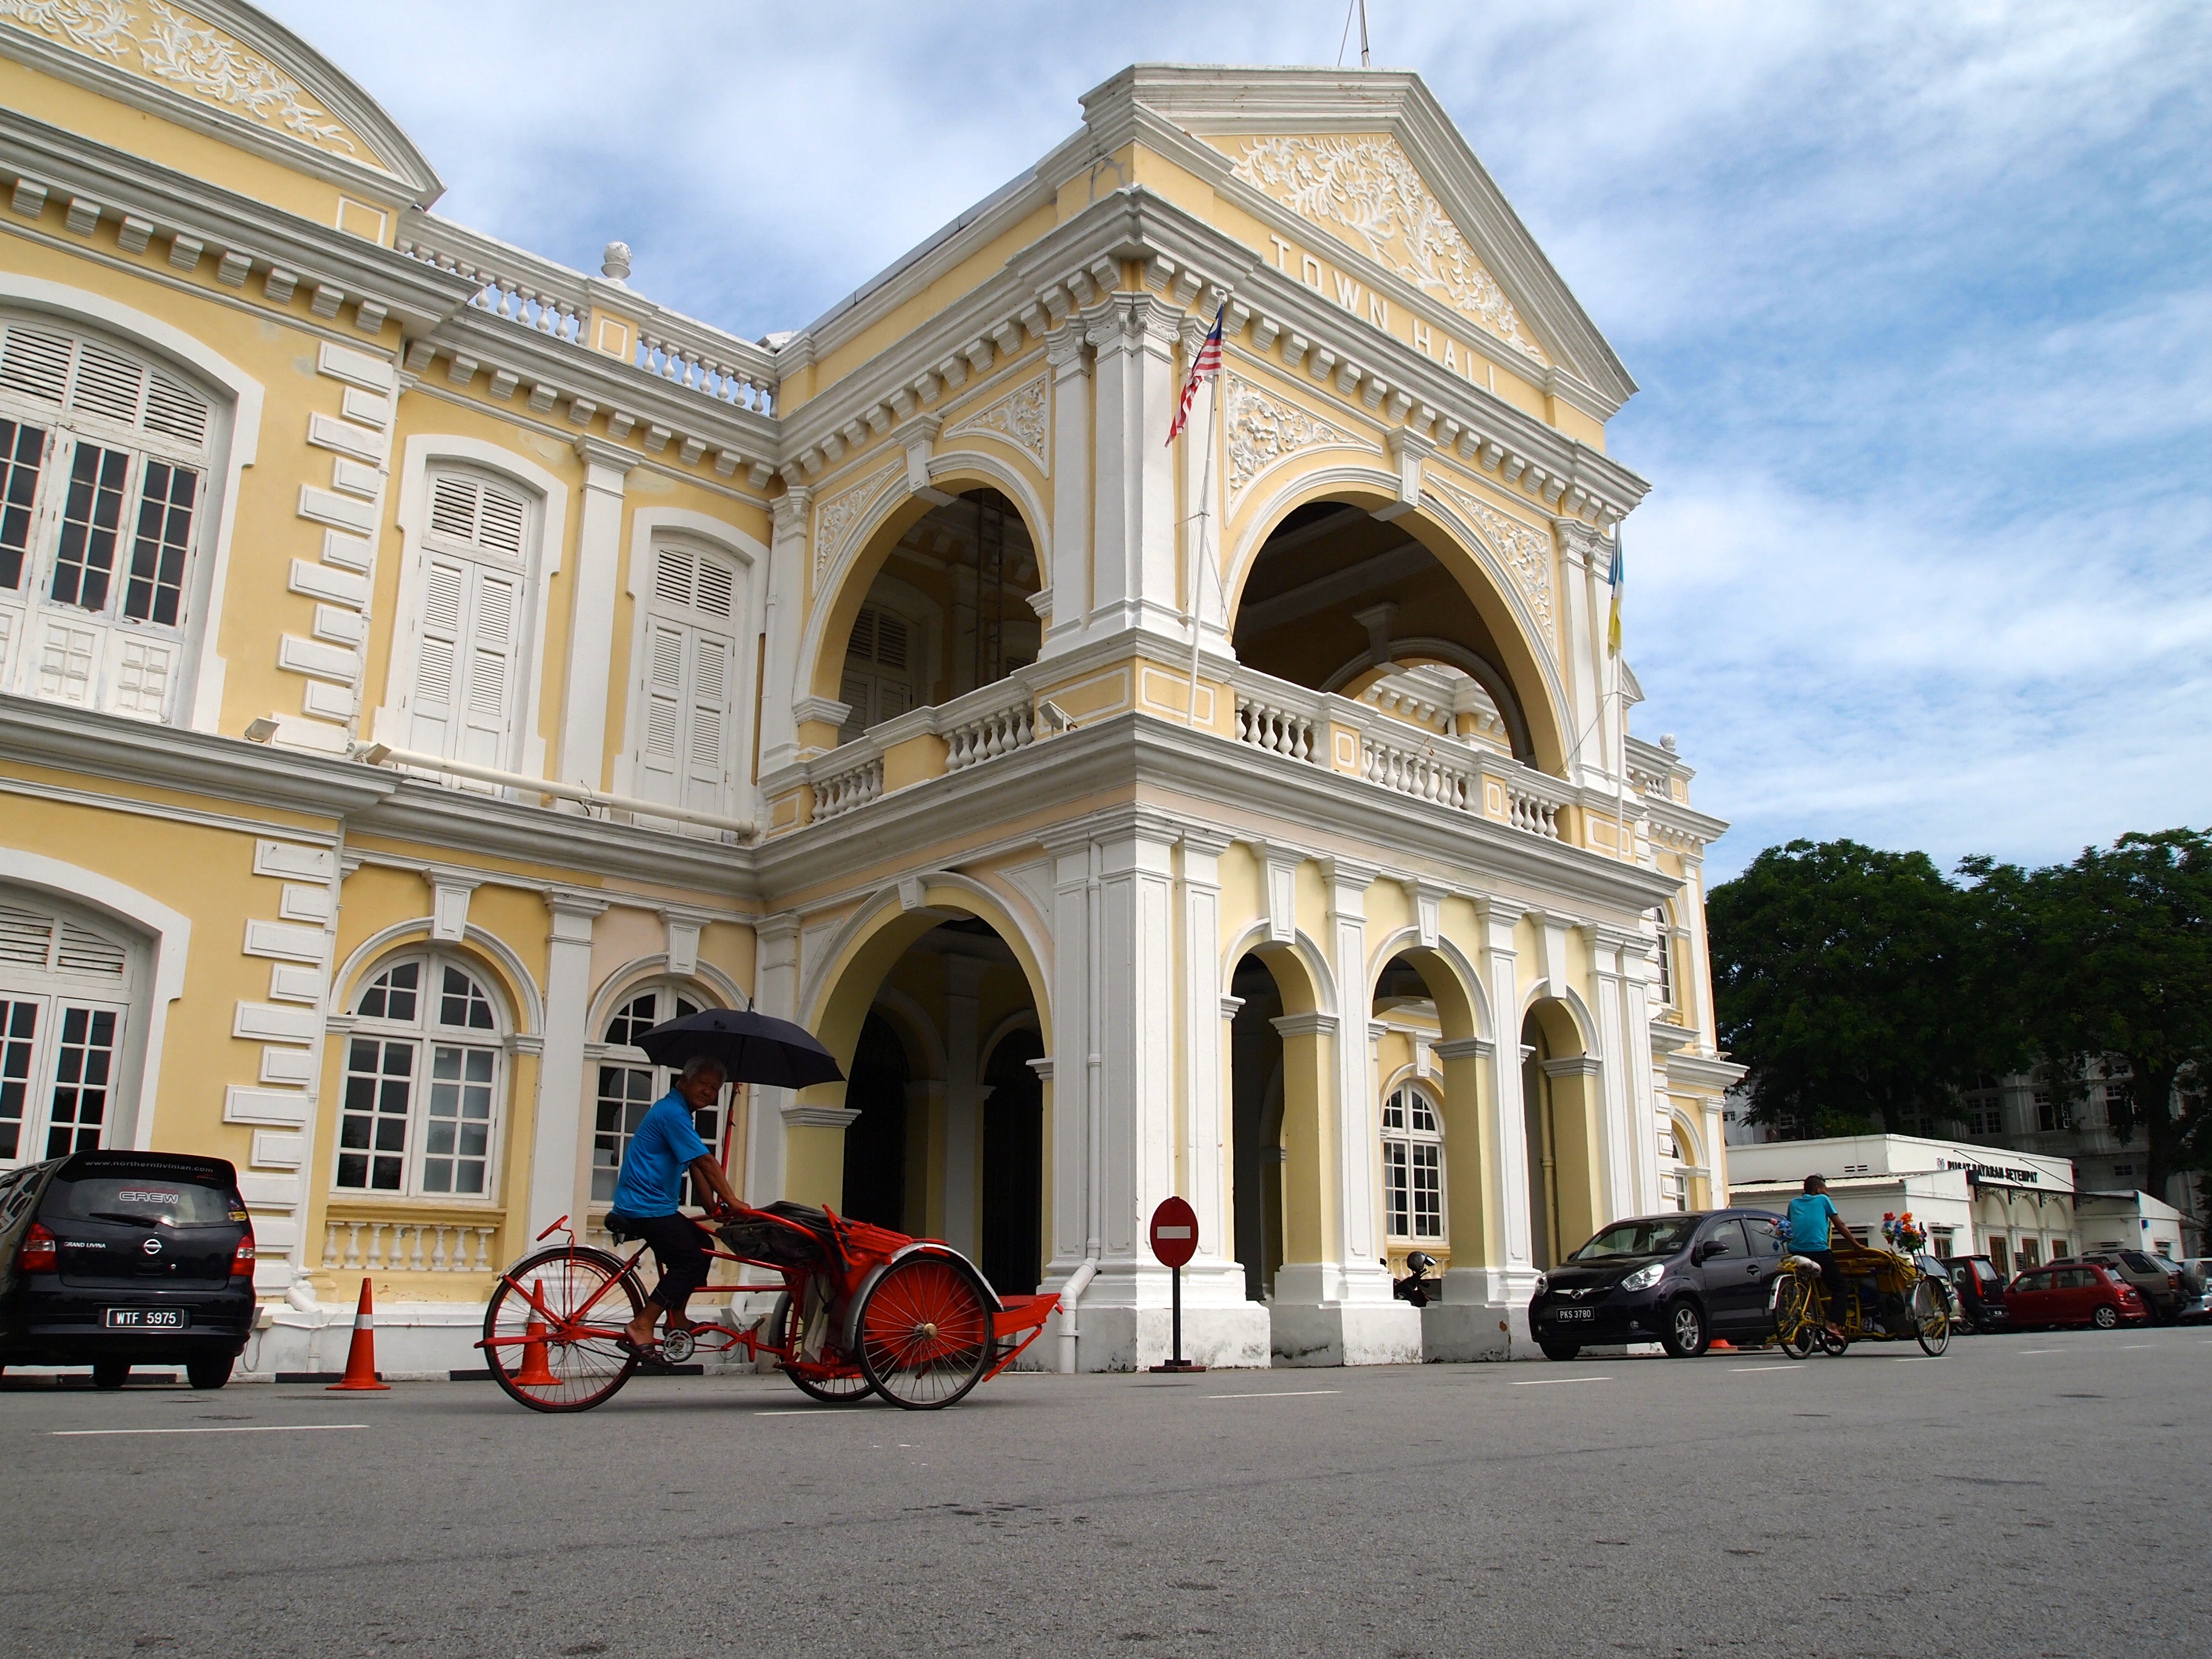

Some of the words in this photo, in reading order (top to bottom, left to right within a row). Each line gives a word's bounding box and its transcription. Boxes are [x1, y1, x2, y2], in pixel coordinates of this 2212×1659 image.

[1269, 234, 1388, 330] TOWN
[1413, 319, 1495, 393] HALL
[85, 1161, 213, 1173] www.northernlivinian.com
[2005, 1167, 2038, 1183] SETEMPAT
[119, 1191, 179, 1204] CREW
[116, 1312, 140, 1324] WTF
[146, 1312, 176, 1324] 5975
[1560, 1310, 1573, 1319] PKS
[1574, 1309, 1591, 1318] 3780
